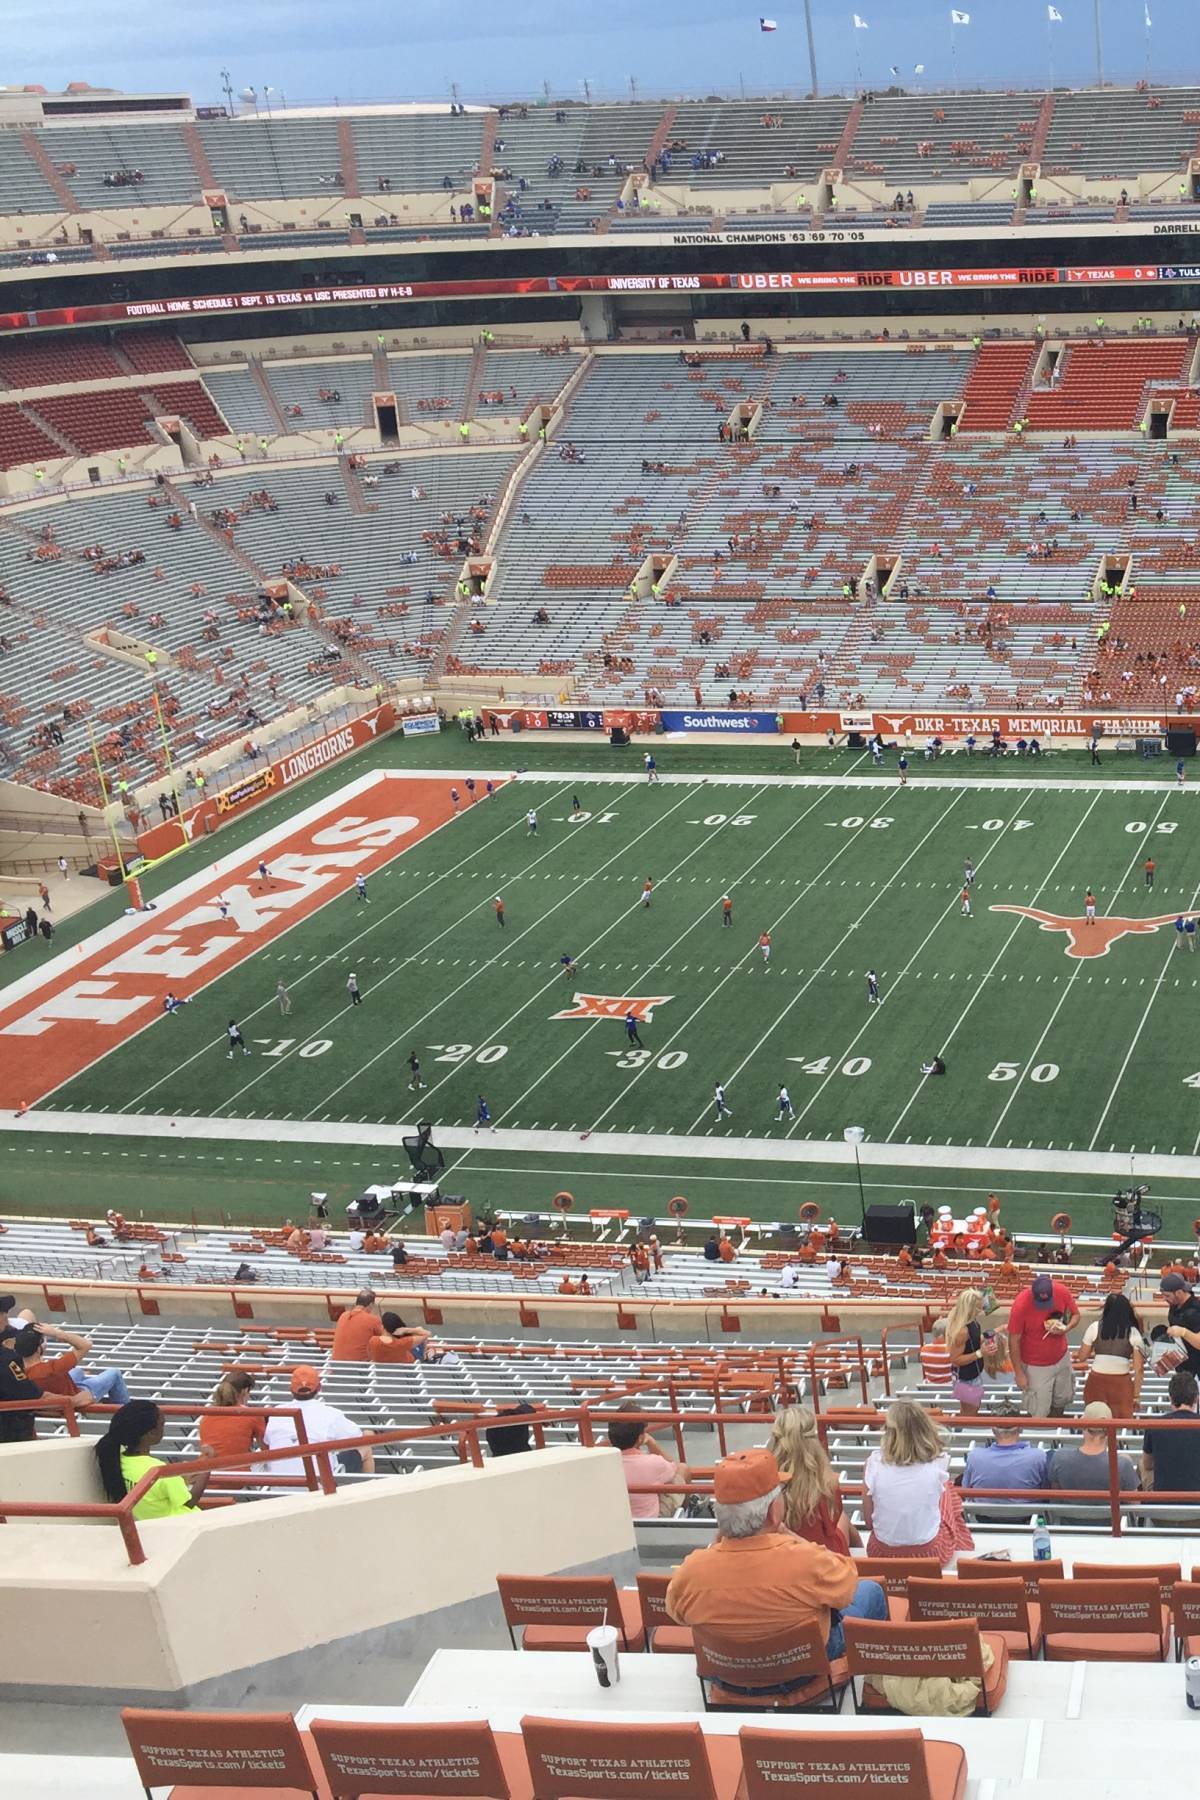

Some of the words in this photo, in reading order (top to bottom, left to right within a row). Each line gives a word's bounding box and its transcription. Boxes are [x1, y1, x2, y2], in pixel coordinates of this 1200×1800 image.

[1154, 224, 1200, 234] DARRELL
[674, 234, 722, 244] NATIONAL
[726, 234, 786, 244] CHAMPIONS
[789, 232, 806, 242] '63
[808, 232, 826, 242] '69
[828, 232, 845, 242] '70
[848, 232, 865, 241] '05
[740, 274, 793, 288] UBER
[857, 272, 893, 286] RIDE
[900, 272, 953, 286] UBER
[1018, 270, 1055, 283] RIDE
[1087, 270, 1115, 279] TEXAS
[1134, 269, 1142, 278] 0
[608, 276, 654, 290] UNIVERSITY
[658, 276, 670, 289] OF
[672, 276, 700, 289] TEXAS
[126, 303, 166, 316] FOOTBALL
[167, 300, 192, 312] HOME
[192, 298, 233, 310] SCHEDULE
[241, 296, 263, 306] SEPT.
[264, 294, 275, 305] 15
[276, 293, 302, 304] TEXAS
[304, 294, 313, 302] vs
[314, 292, 332, 300] USC
[332, 288, 377, 300] PRESENTED
[378, 288, 389, 298] BY
[390, 286, 412, 296] H-E-B
[684, 716, 750, 729] Southwest
[914, 718, 1000, 733] DKR-TEXAS
[1008, 718, 1086, 734] MEMORIAL
[280, 728, 355, 785] LONGHORNS
[0, 816, 420, 1036] TEXAS
[260, 1038, 334, 1058] 10
[434, 1044, 508, 1064] 20
[615, 1050, 689, 1070] 30
[801, 1055, 873, 1076] 40
[988, 1062, 1060, 1082] 50
[854, 1642, 890, 1652] SUPPORT
[921, 1642, 968, 1652] ATHLETICS
[140, 1745, 185, 1758] SUPPORT
[188, 1748, 222, 1758] TEXAS
[226, 1748, 286, 1759] ATHLETICS
[330, 1753, 376, 1766] SUPPORT
[380, 1757, 416, 1767] TEXAS
[419, 1756, 480, 1767] ATHLETICS
[541, 1754, 587, 1767] SUPPORT
[590, 1758, 628, 1768] TEXAS
[630, 1758, 691, 1769] ATHLETICS
[756, 1760, 804, 1770] SUPPORT
[808, 1762, 847, 1772] TEXAS
[849, 1762, 912, 1772] ATHLETICS
